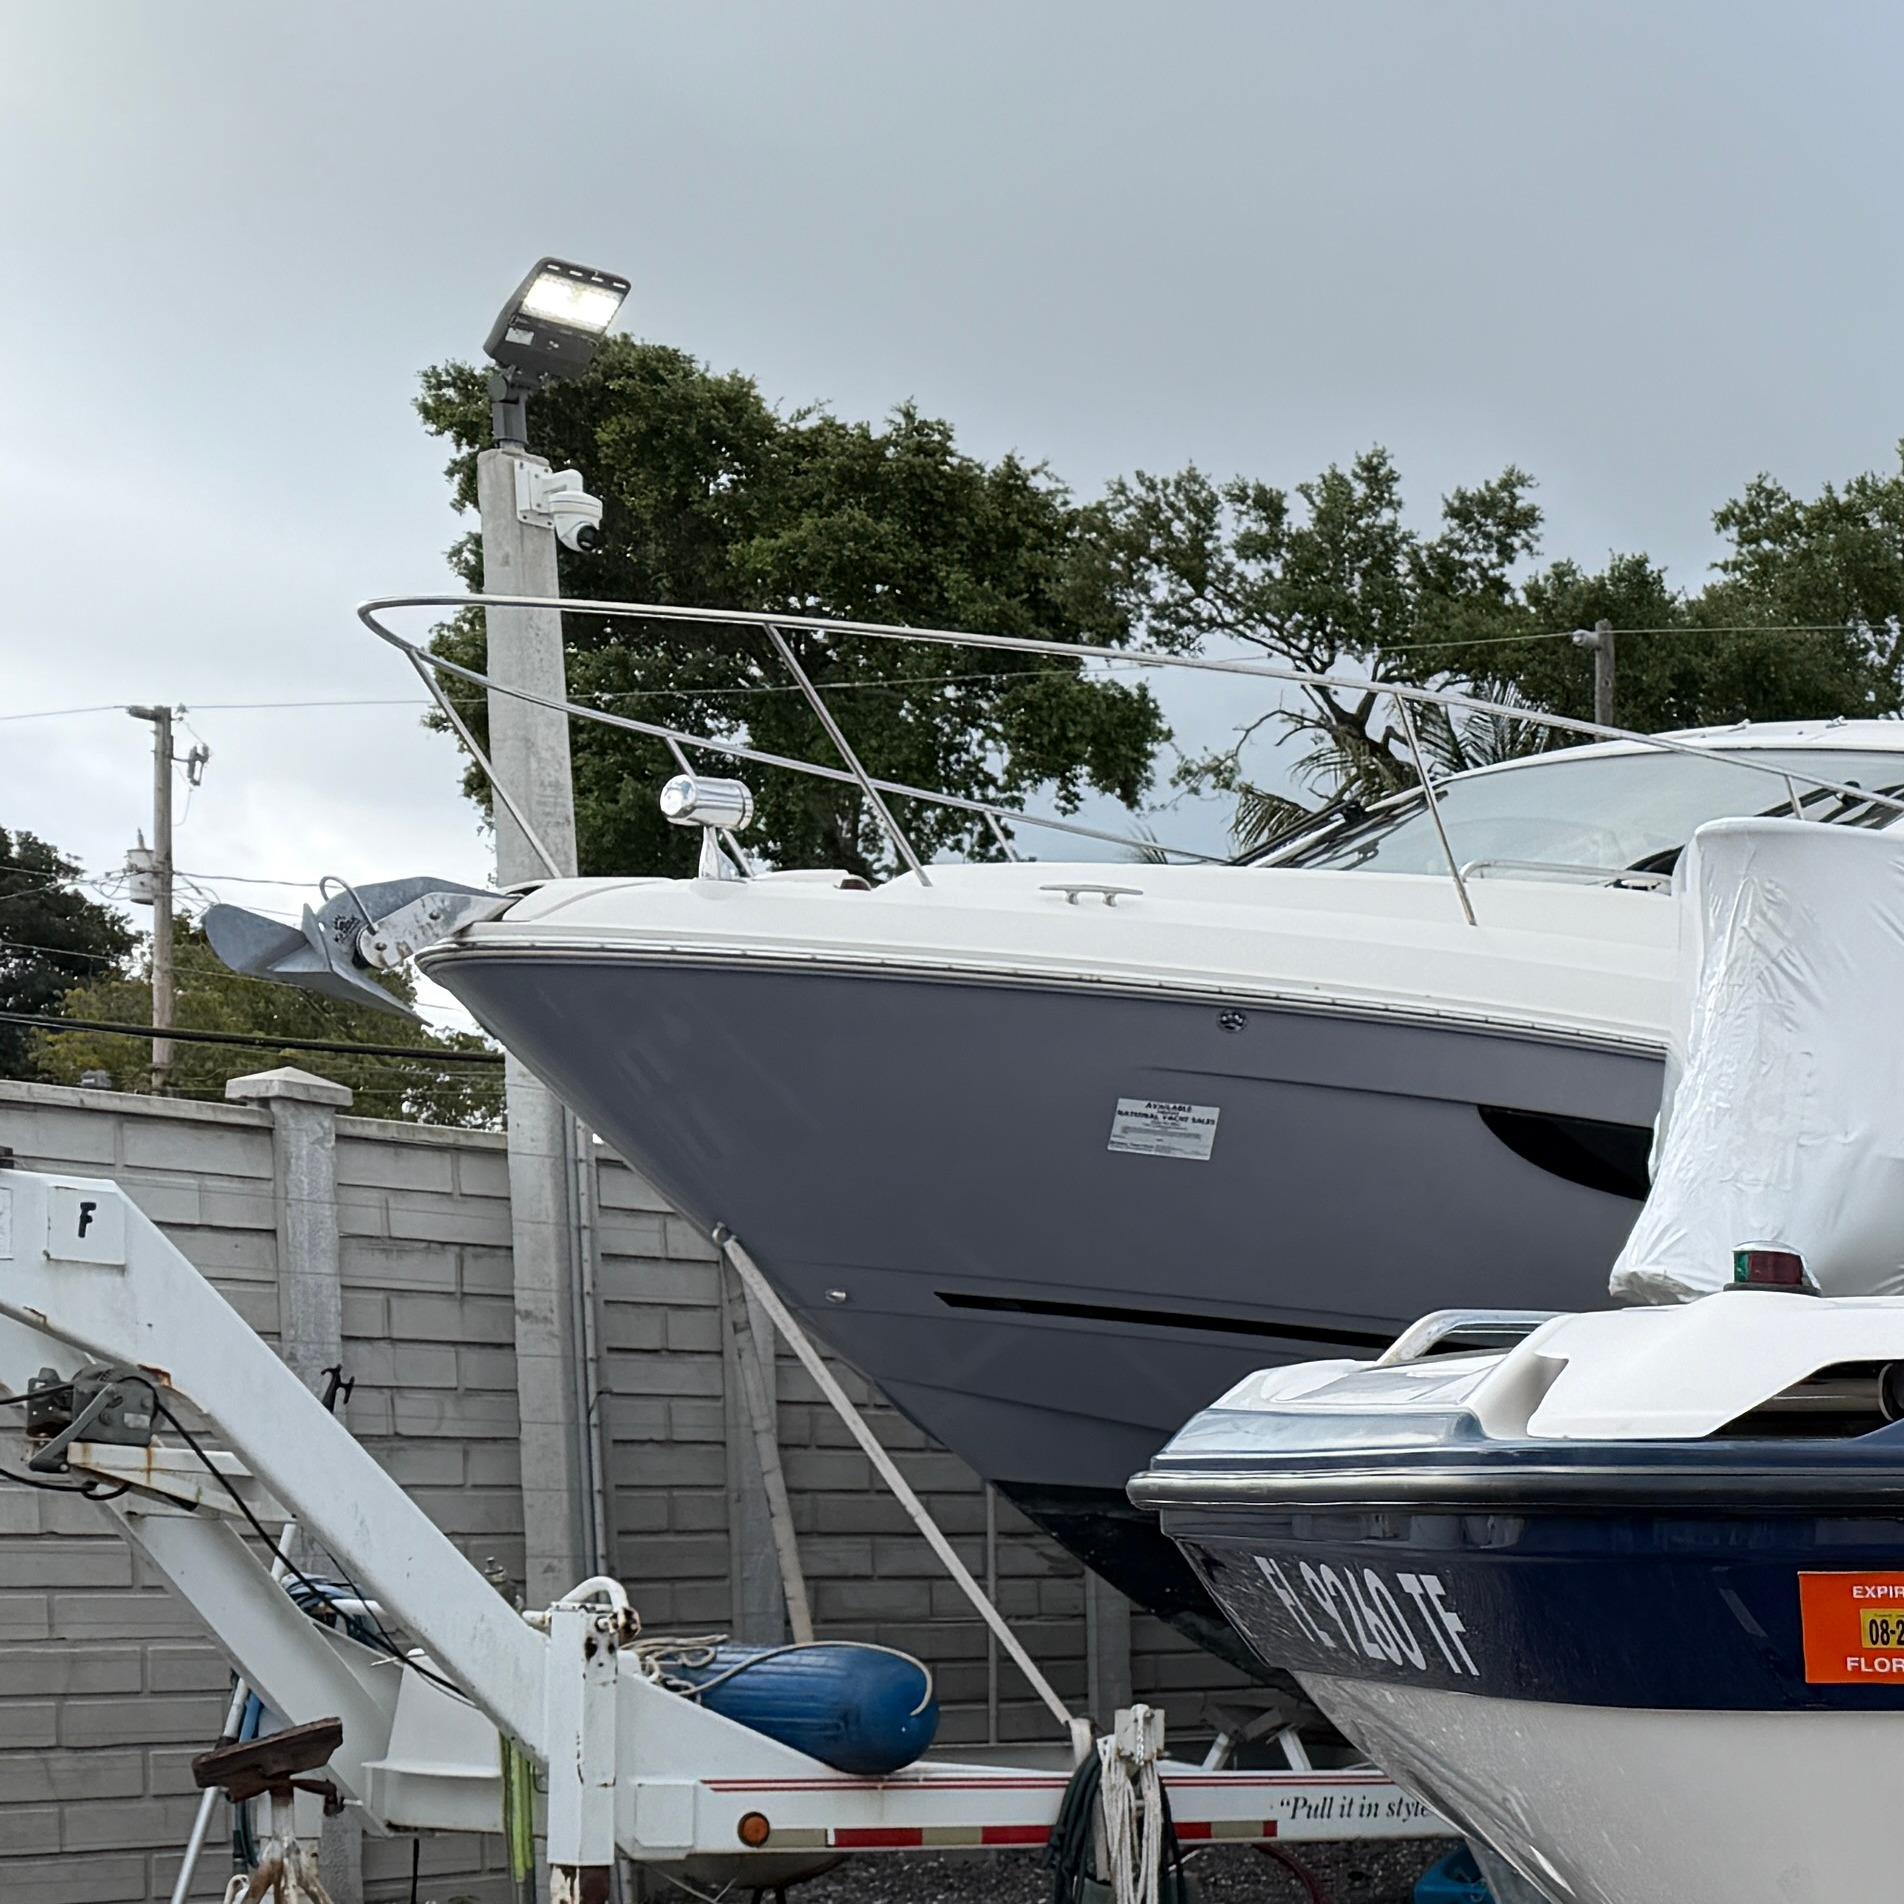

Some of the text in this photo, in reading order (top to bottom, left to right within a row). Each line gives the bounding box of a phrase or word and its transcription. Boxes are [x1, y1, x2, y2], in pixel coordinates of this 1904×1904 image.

[77, 1201, 97, 1239] F
[1253, 1555, 1481, 1677] FL 9260 TF
[1339, 1795, 1354, 1820] it
[1359, 1795, 1379, 1819] in
